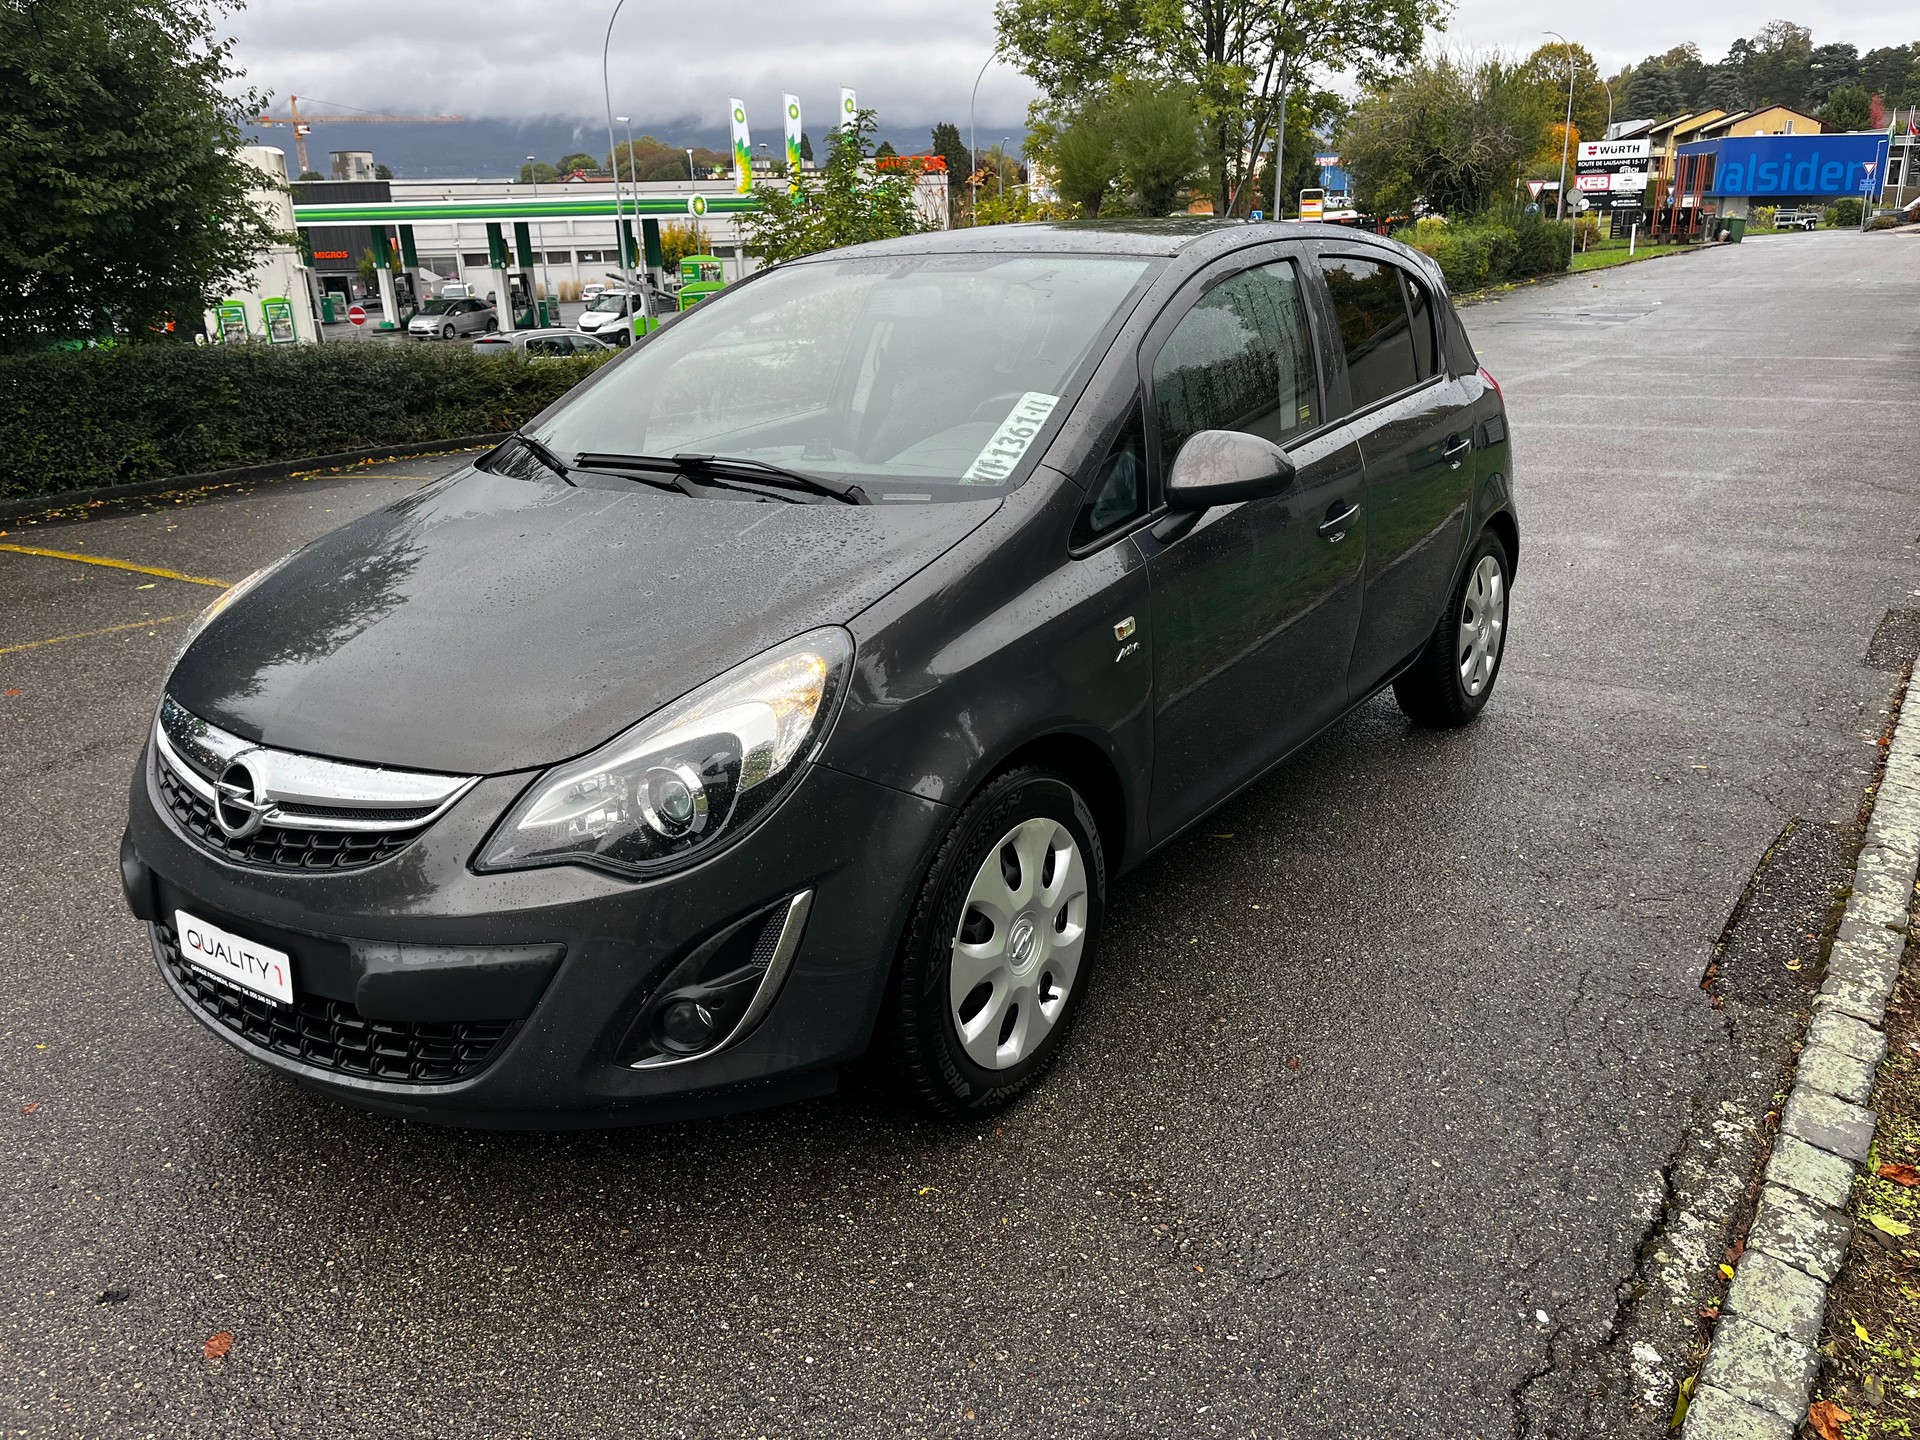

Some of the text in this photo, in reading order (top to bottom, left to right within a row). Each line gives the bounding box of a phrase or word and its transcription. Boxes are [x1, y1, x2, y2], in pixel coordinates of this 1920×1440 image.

[1600, 145, 1640, 154] WÜRTH
[1576, 177, 1609, 190] KEB
[314, 251, 348, 259] MIGROS
[187, 929, 283, 986] QUALITY 1
